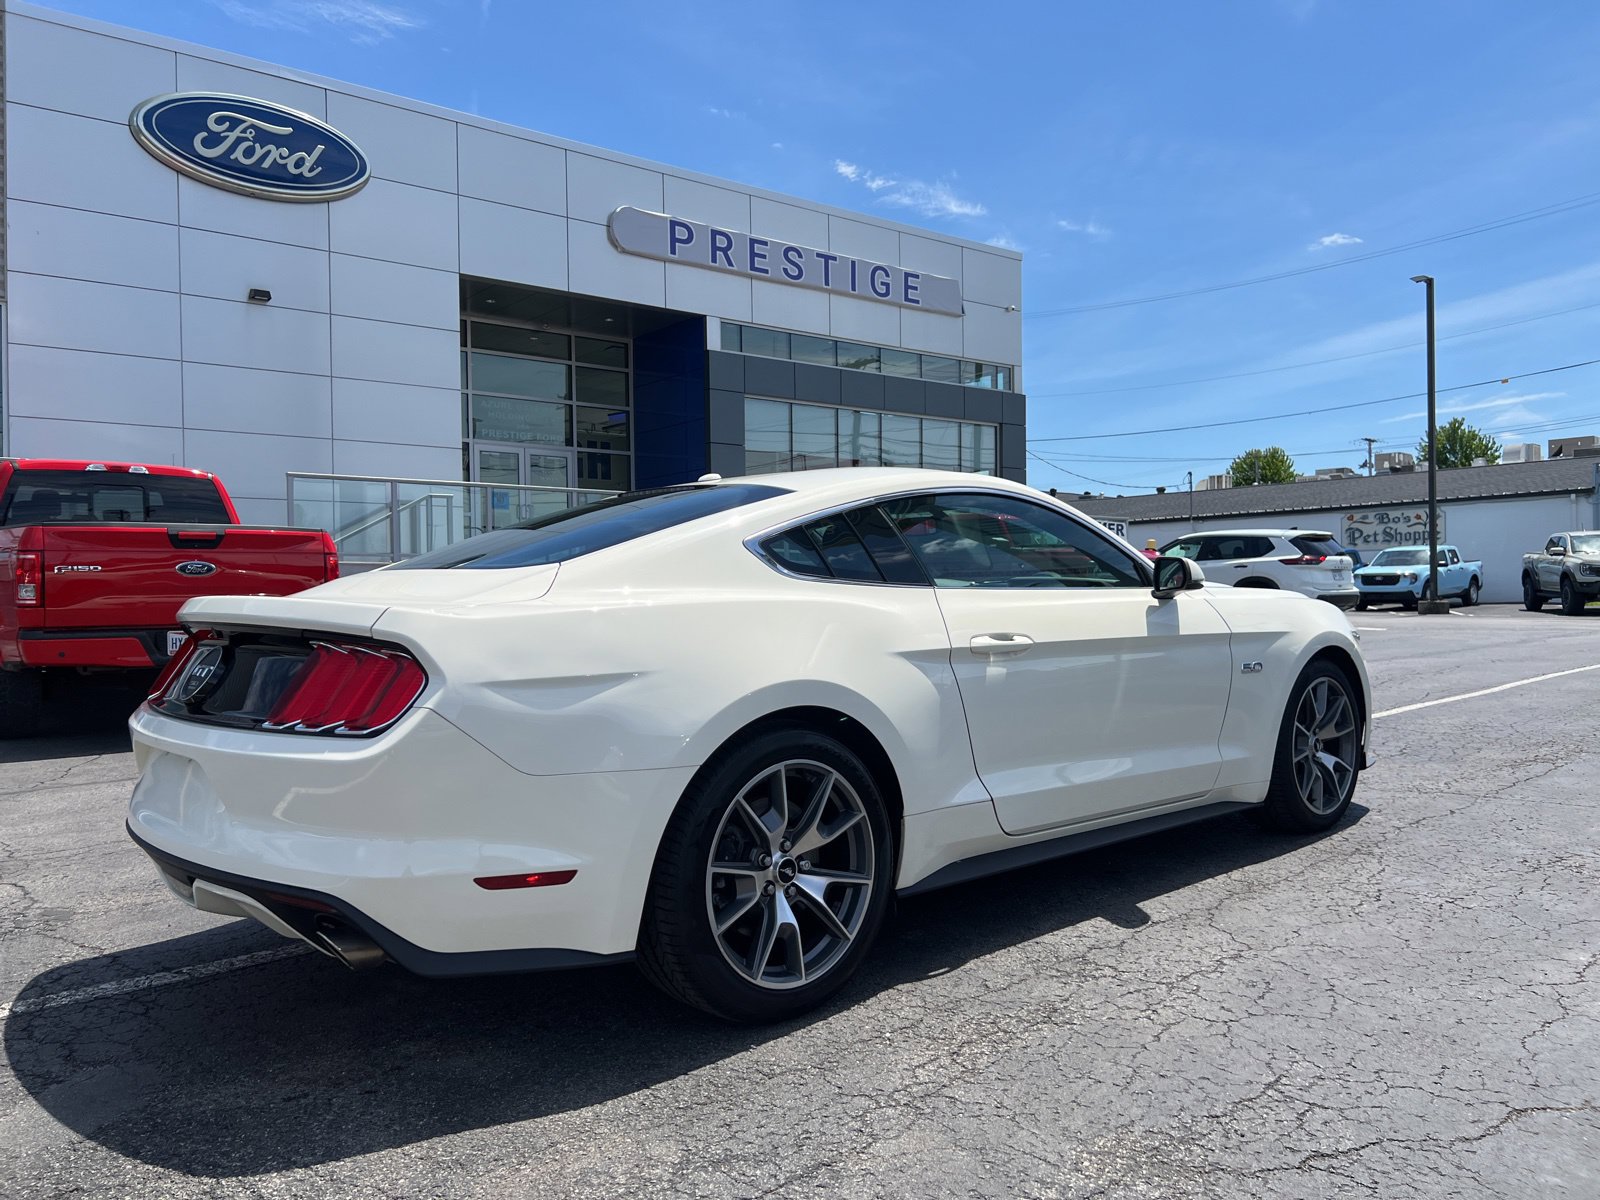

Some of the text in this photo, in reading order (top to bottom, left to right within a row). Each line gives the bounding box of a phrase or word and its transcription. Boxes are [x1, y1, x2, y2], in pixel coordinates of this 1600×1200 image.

[193, 111, 325, 178] Ford
[668, 219, 921, 305] PRESTIGE
[481, 428, 532, 441] PRESTIGE
[1374, 512, 1412, 525] Bo's
[1345, 527, 1379, 546] Pet
[185, 564, 208, 574] Ford
[1241, 661, 1263, 673] 5.0
